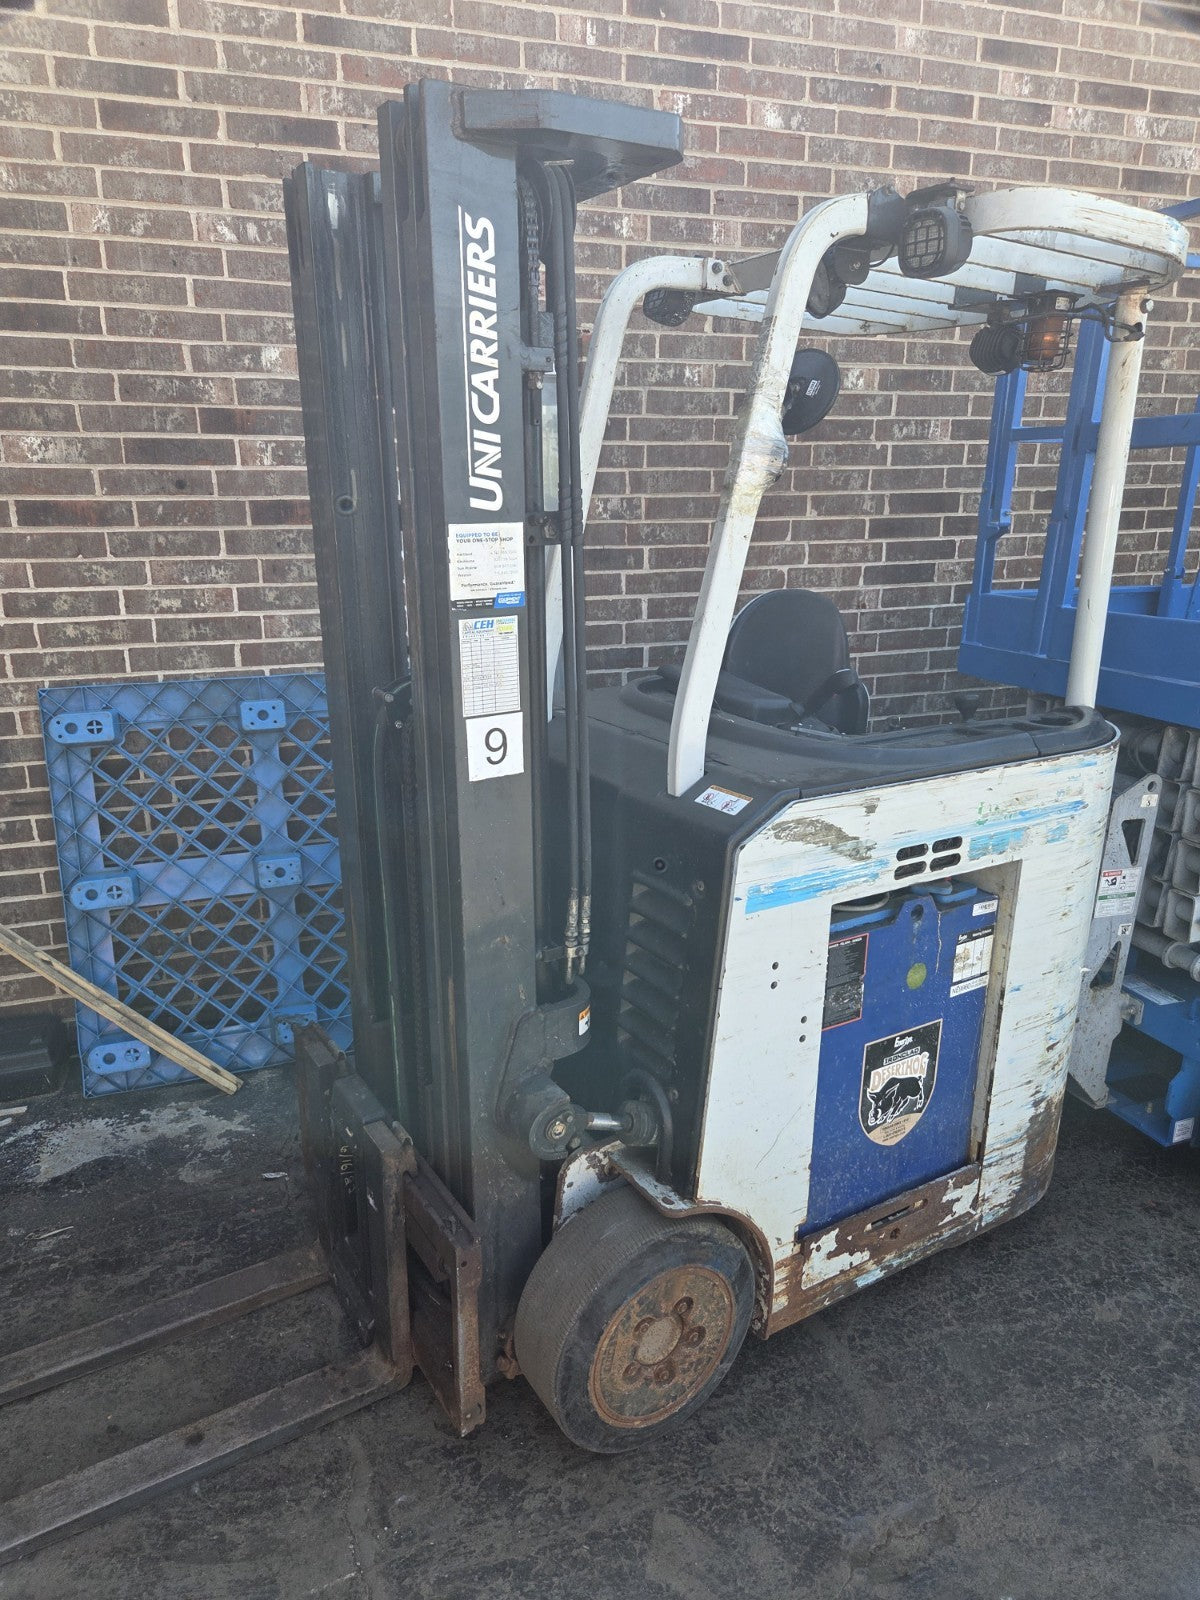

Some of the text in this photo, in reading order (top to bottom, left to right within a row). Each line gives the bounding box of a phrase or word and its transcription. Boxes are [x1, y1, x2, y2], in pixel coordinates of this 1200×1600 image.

[474, 619, 494, 630] CEH
[485, 727, 508, 765] 9
[884, 1047, 920, 1065] IRONCLAD
[870, 1051, 930, 1093] DESERTHOG
